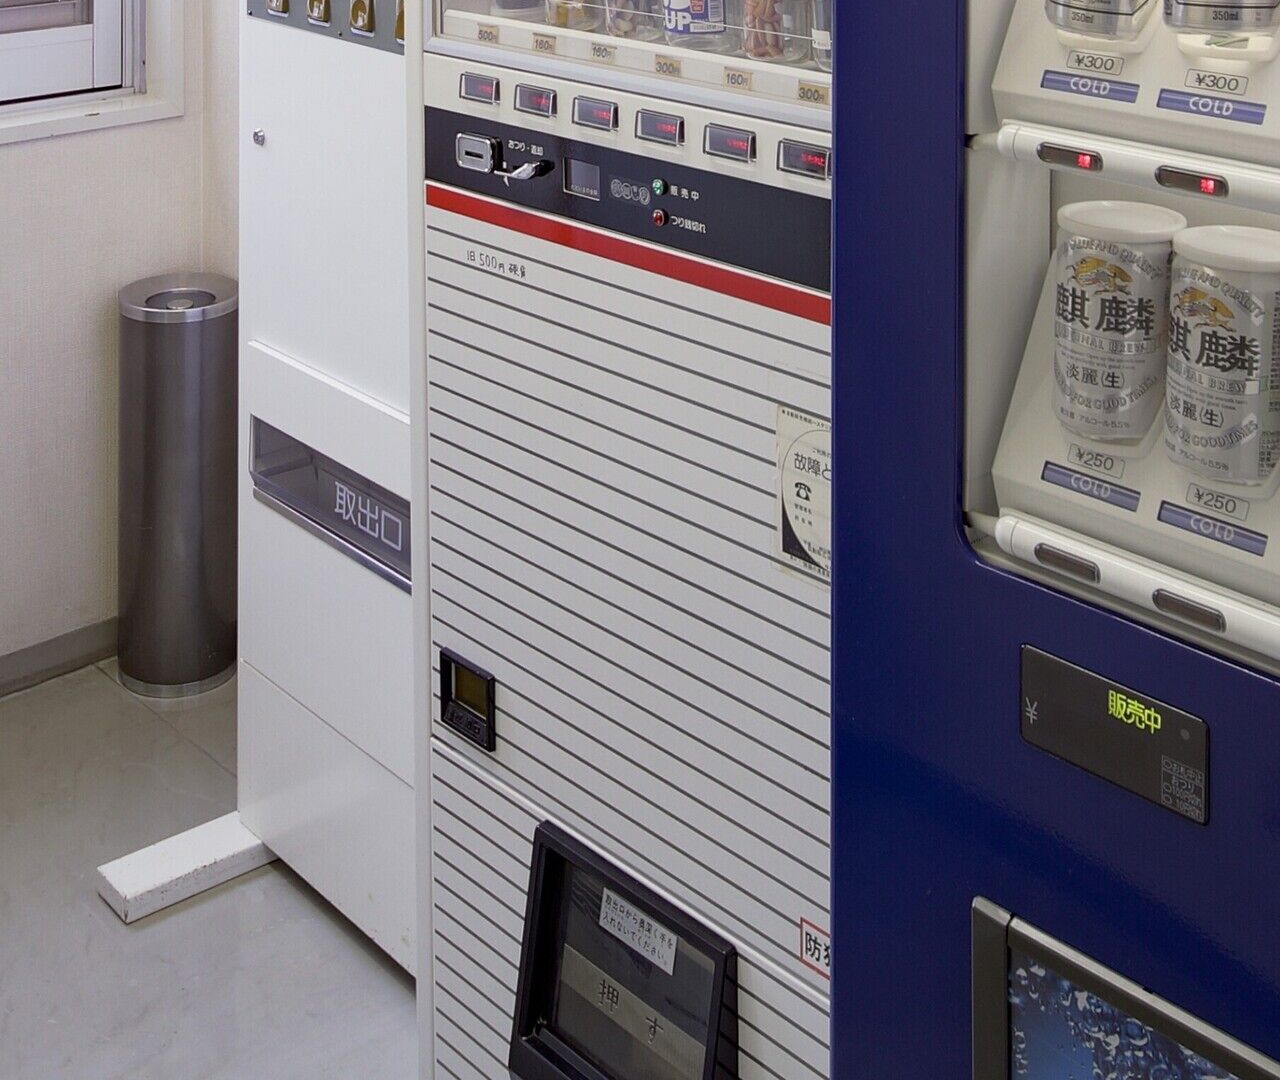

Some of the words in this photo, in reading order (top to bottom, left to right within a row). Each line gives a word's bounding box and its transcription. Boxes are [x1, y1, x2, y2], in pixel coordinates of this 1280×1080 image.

[1212, 10, 1239, 21] 350ml
[1074, 54, 1115, 70] ¥300
[1070, 77, 1111, 95] COLD
[1194, 72, 1239, 90] ¥300
[798, 86, 825, 102] 300円
[1189, 97, 1234, 116] COLD
[670, 183, 700, 201] 販売中
[1056, 282, 1155, 341] 麒麟
[1075, 448, 1114, 470] ¥250
[1070, 474, 1113, 499] COLD
[1194, 487, 1238, 513] ¥250
[334, 480, 403, 552] 取出口
[1190, 517, 1235, 542] COLD
[1025, 696, 1038, 724] ¥
[1107, 689, 1162, 735] 販売中
[598, 978, 664, 1045] 押す
